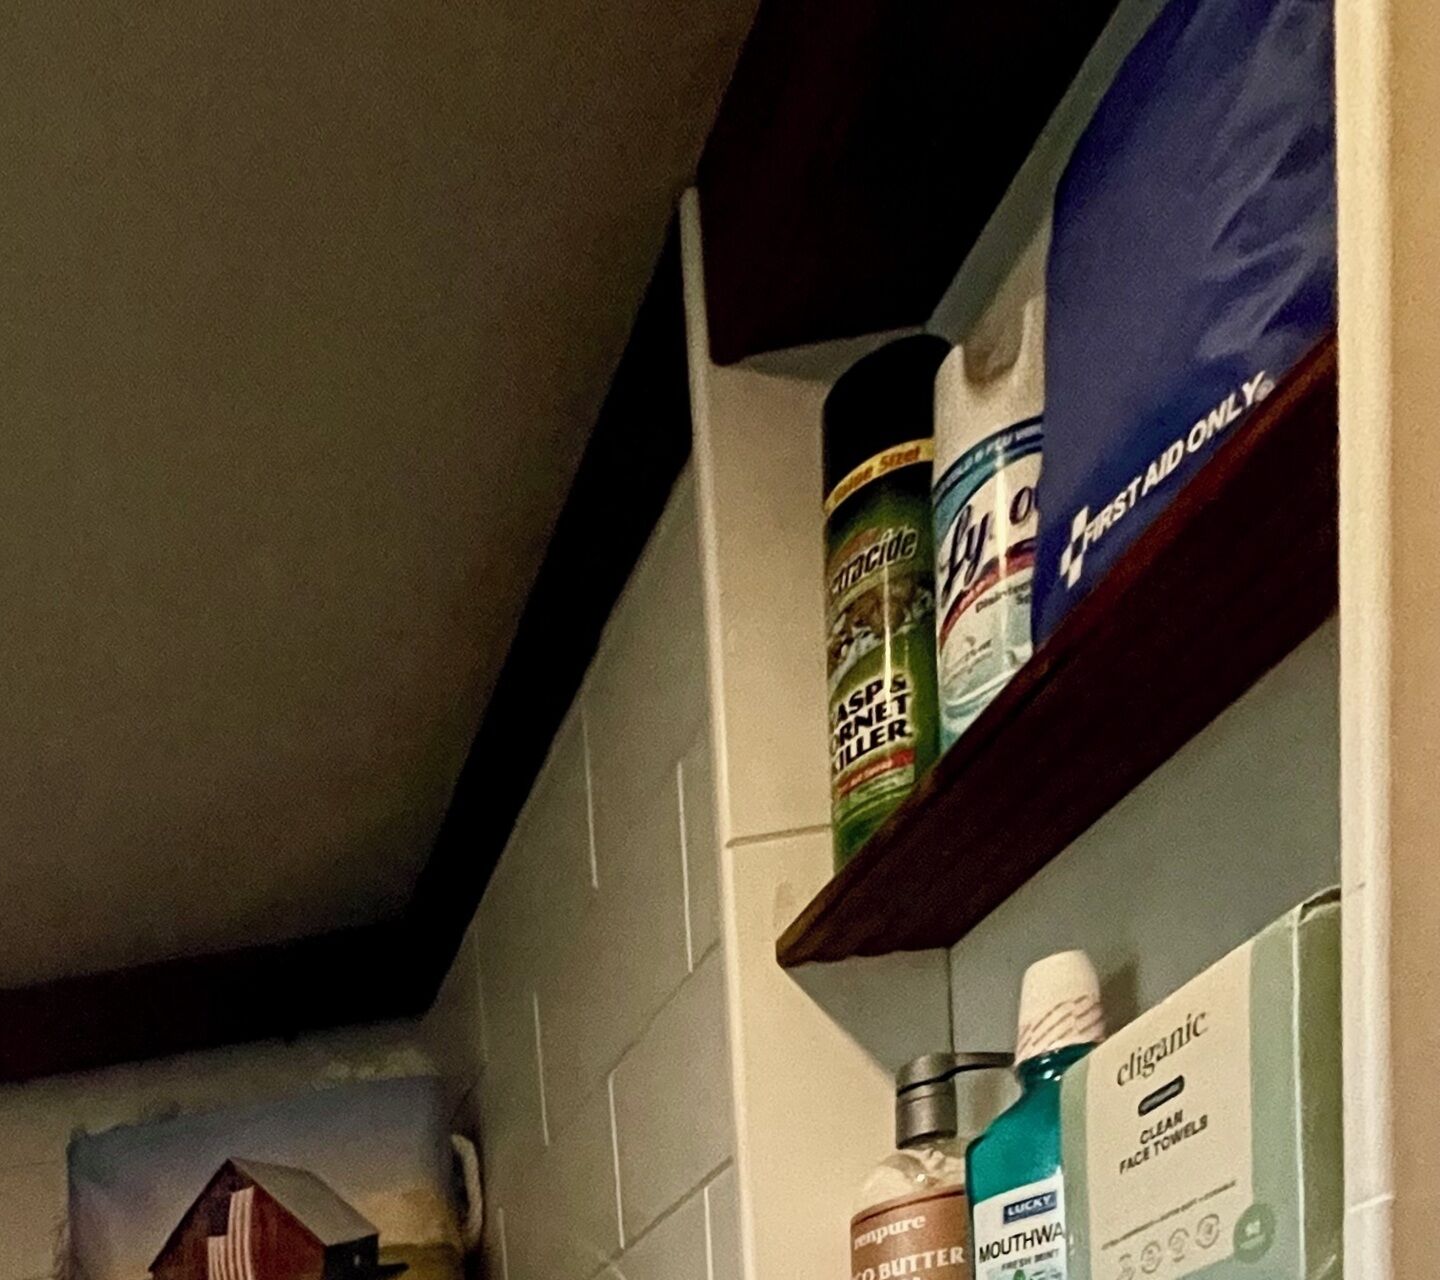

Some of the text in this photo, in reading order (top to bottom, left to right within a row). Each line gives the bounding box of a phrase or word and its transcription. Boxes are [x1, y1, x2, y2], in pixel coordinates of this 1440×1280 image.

[1082, 370, 1266, 553] FIRST AID ONLY
[830, 679, 884, 726] ASP
[1116, 1012, 1209, 1087] cliganic
[1119, 1114, 1208, 1175] FACE TOWELS
[1139, 1109, 1184, 1145] CLEAN
[1007, 1194, 1052, 1216] LUCKY
[878, 1246, 965, 1280] BUTTER
